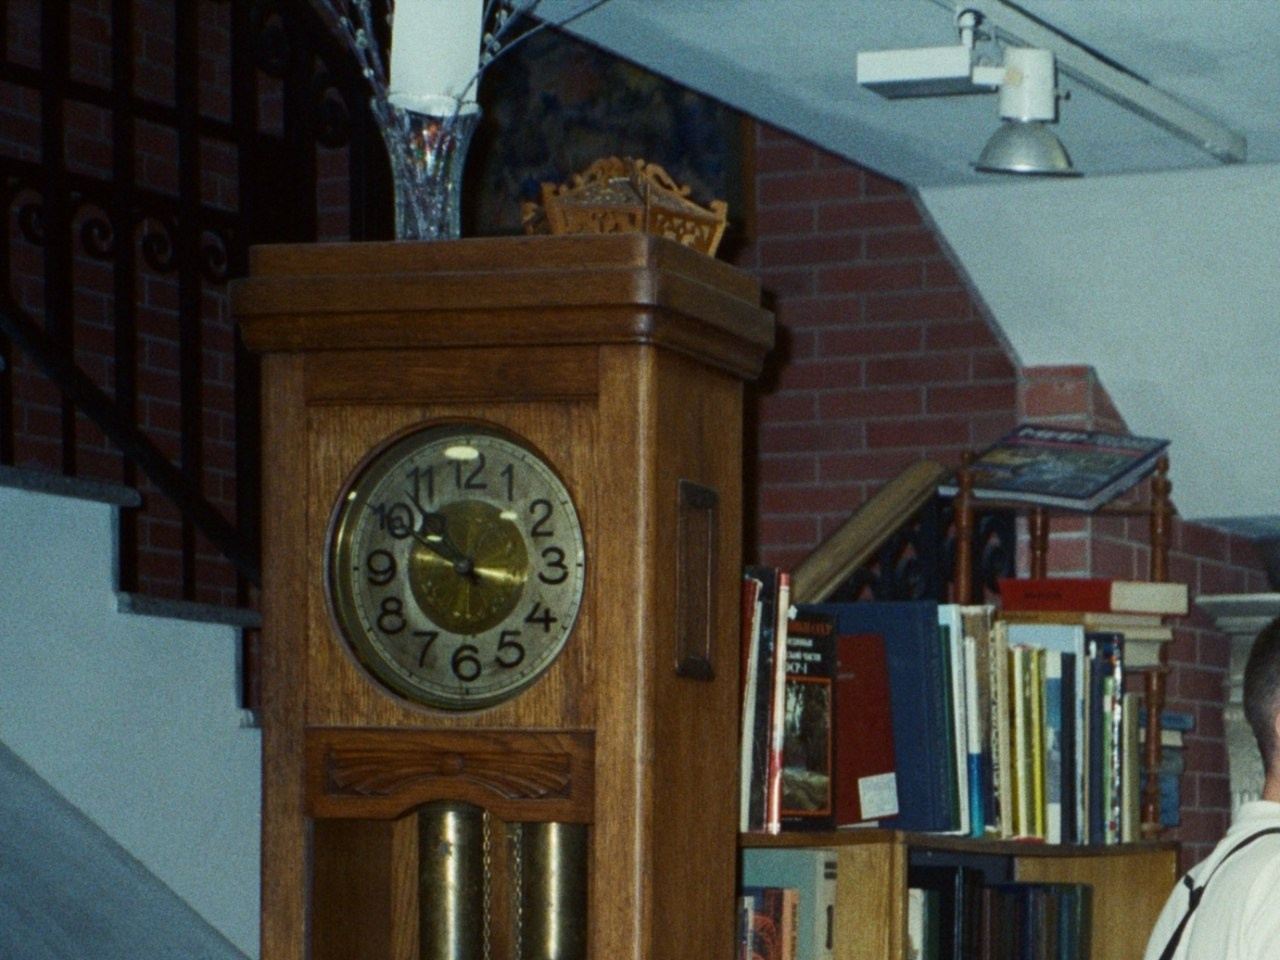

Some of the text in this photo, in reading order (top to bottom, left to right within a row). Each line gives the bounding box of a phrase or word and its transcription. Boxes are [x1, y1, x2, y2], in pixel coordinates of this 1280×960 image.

[405, 465, 434, 503] 11
[446, 450, 487, 490] 12
[499, 463, 514, 501] 1
[374, 501, 415, 540] 10
[529, 498, 554, 537] 2
[366, 548, 397, 586] 9
[538, 547, 569, 585] 3
[376, 596, 407, 635] 8
[524, 601, 558, 632] 4
[413, 631, 439, 668] 7
[451, 644, 482, 682] 6
[495, 630, 525, 668] 5
